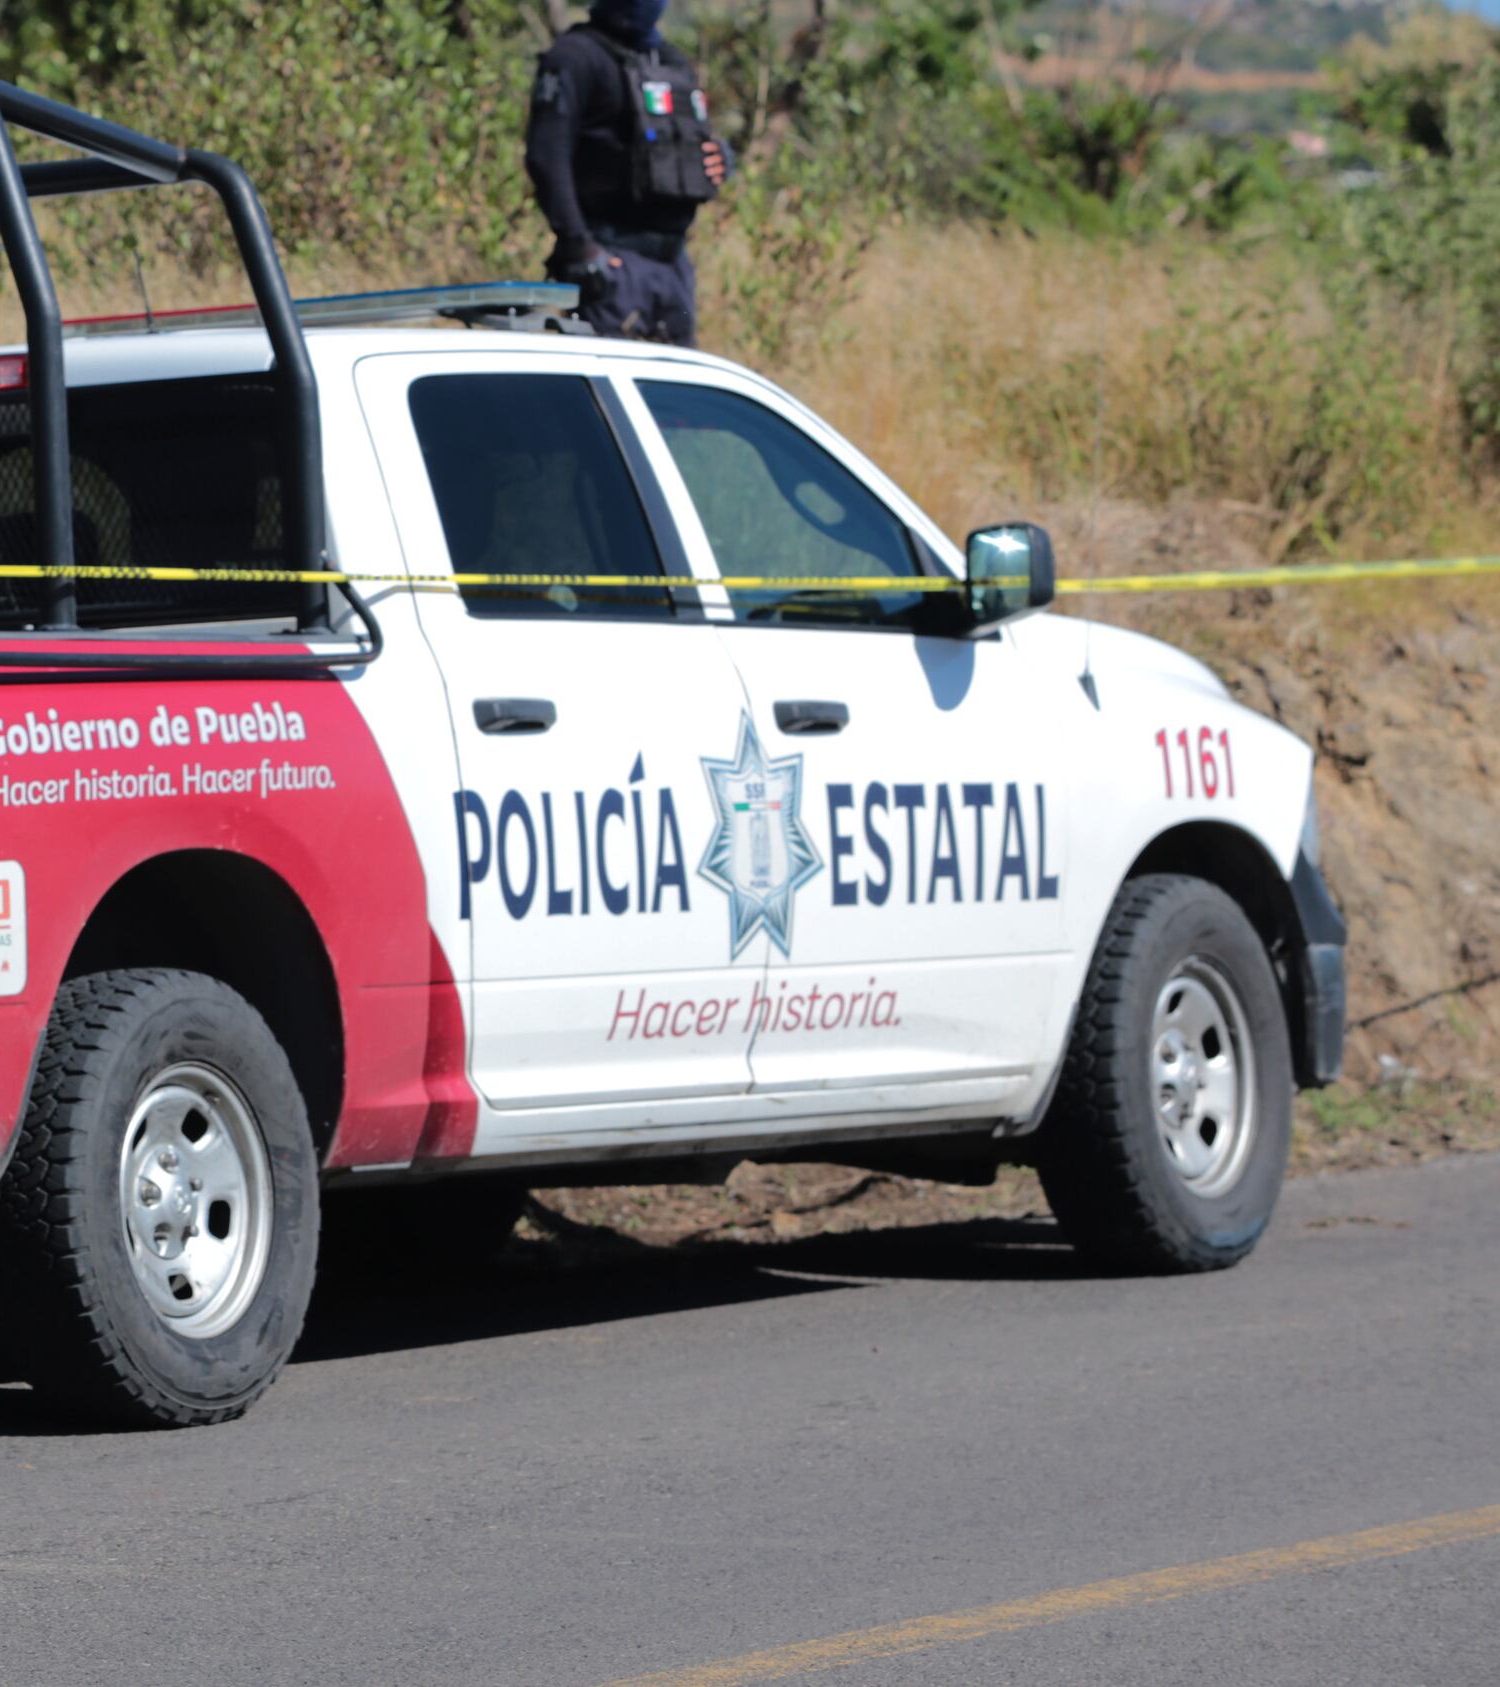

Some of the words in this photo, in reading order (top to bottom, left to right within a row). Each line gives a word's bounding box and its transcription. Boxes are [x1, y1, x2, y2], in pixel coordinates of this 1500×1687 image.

[150, 706, 190, 747] de
[196, 701, 306, 744] Puebla
[74, 755, 177, 801] historia.
[182, 753, 255, 795] Hacer
[260, 748, 335, 798] futuro.
[1155, 725, 1235, 799] 1161
[453, 750, 690, 921] POLICÍA
[826, 781, 1059, 907] ESTATAL
[606, 989, 739, 1042] Hacer
[742, 976, 902, 1034] historia.
